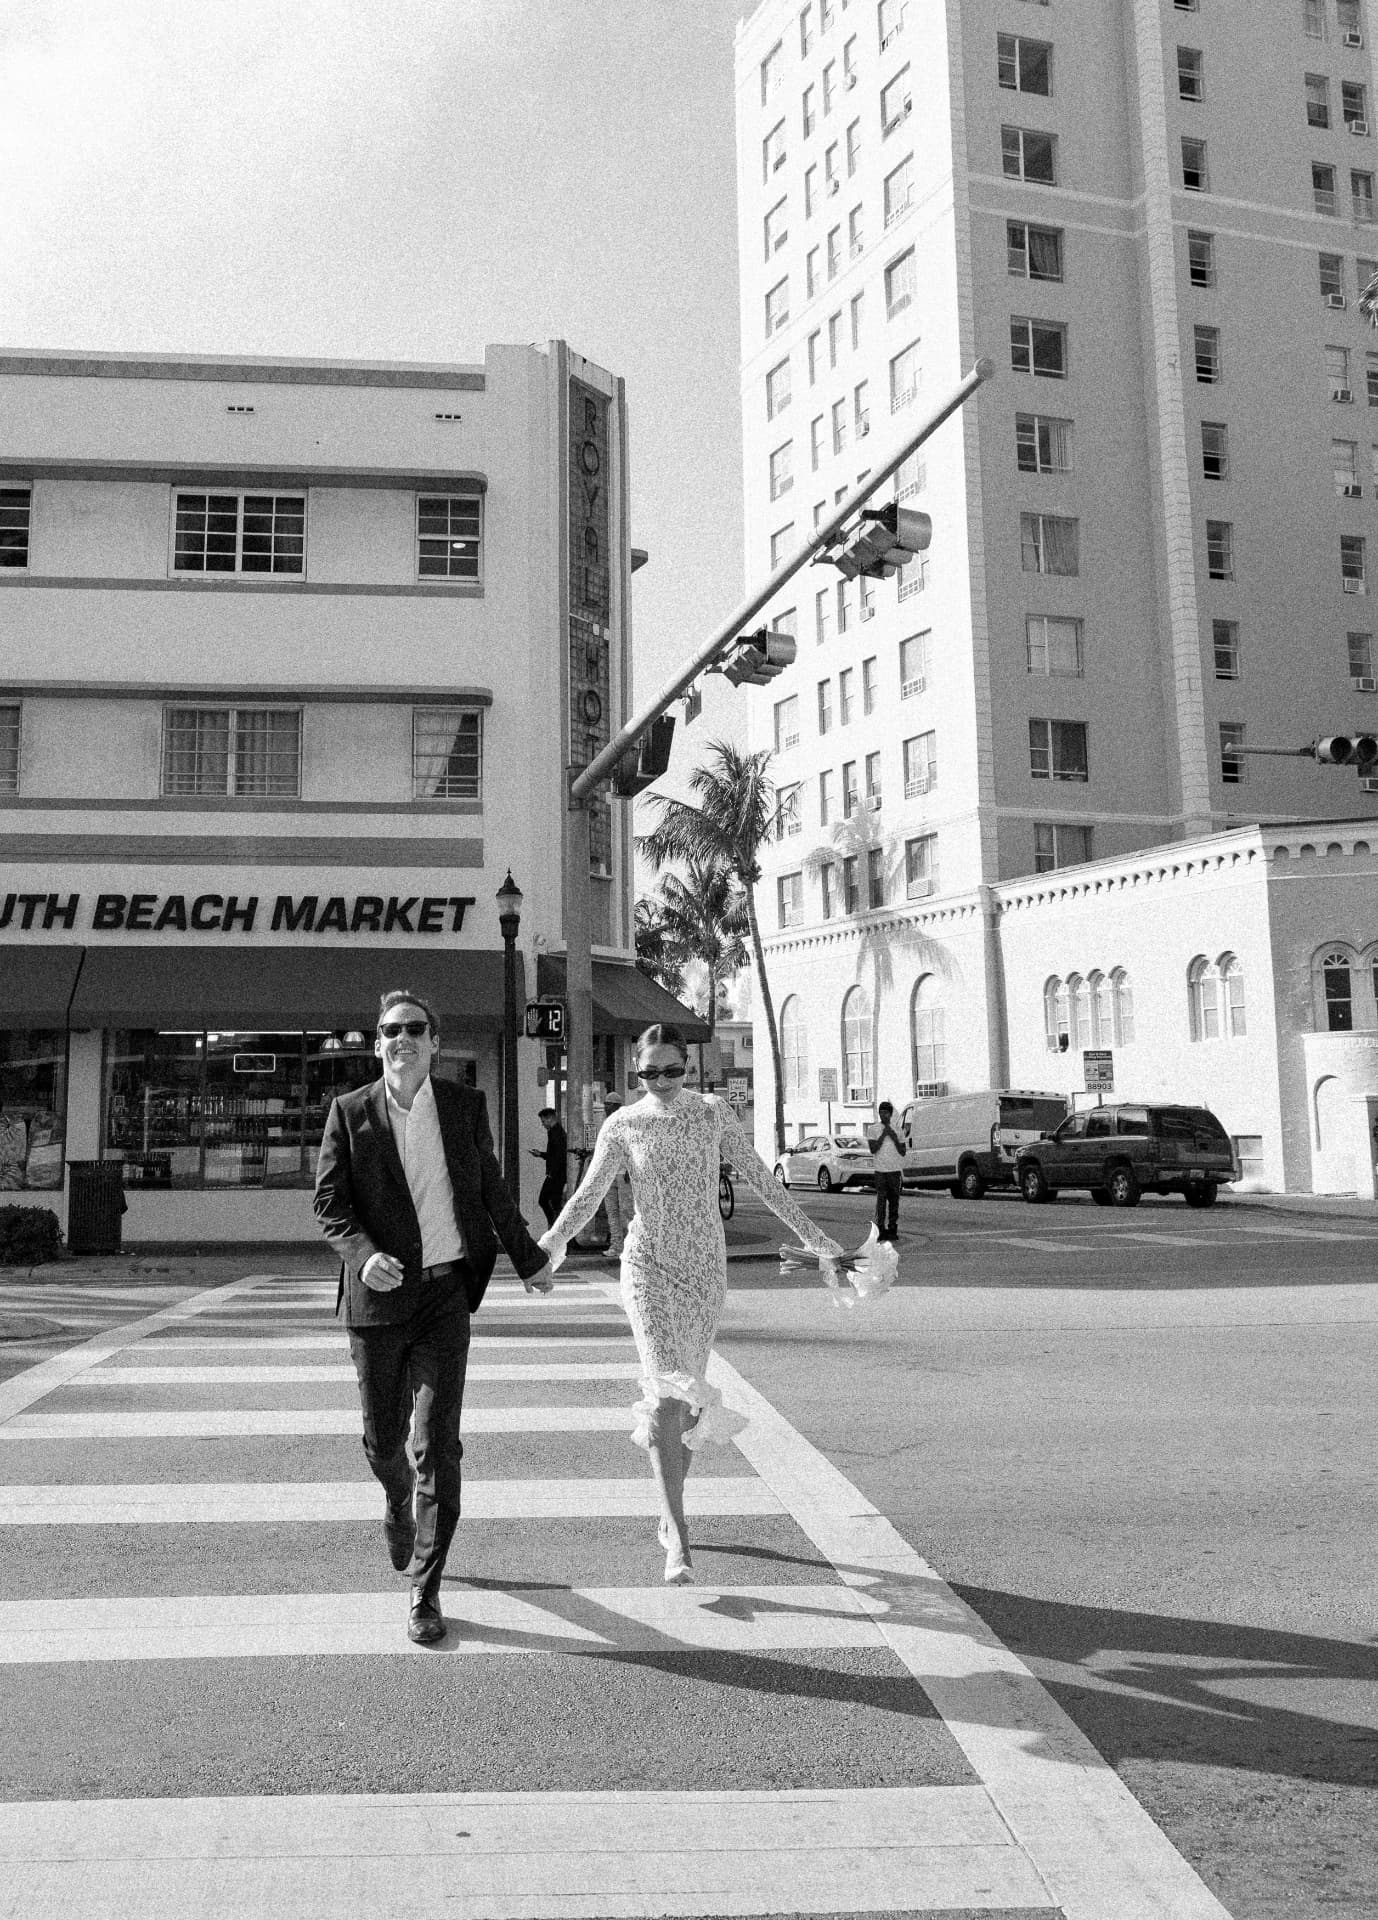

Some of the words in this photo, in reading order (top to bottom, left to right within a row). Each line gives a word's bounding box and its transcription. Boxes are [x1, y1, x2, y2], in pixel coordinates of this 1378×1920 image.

[581, 396, 602, 608] ROYAL
[92, 894, 259, 932] BEACH
[271, 895, 476, 933] MARKET
[548, 1009, 561, 1032] 12
[729, 1091, 746, 1102] 25
